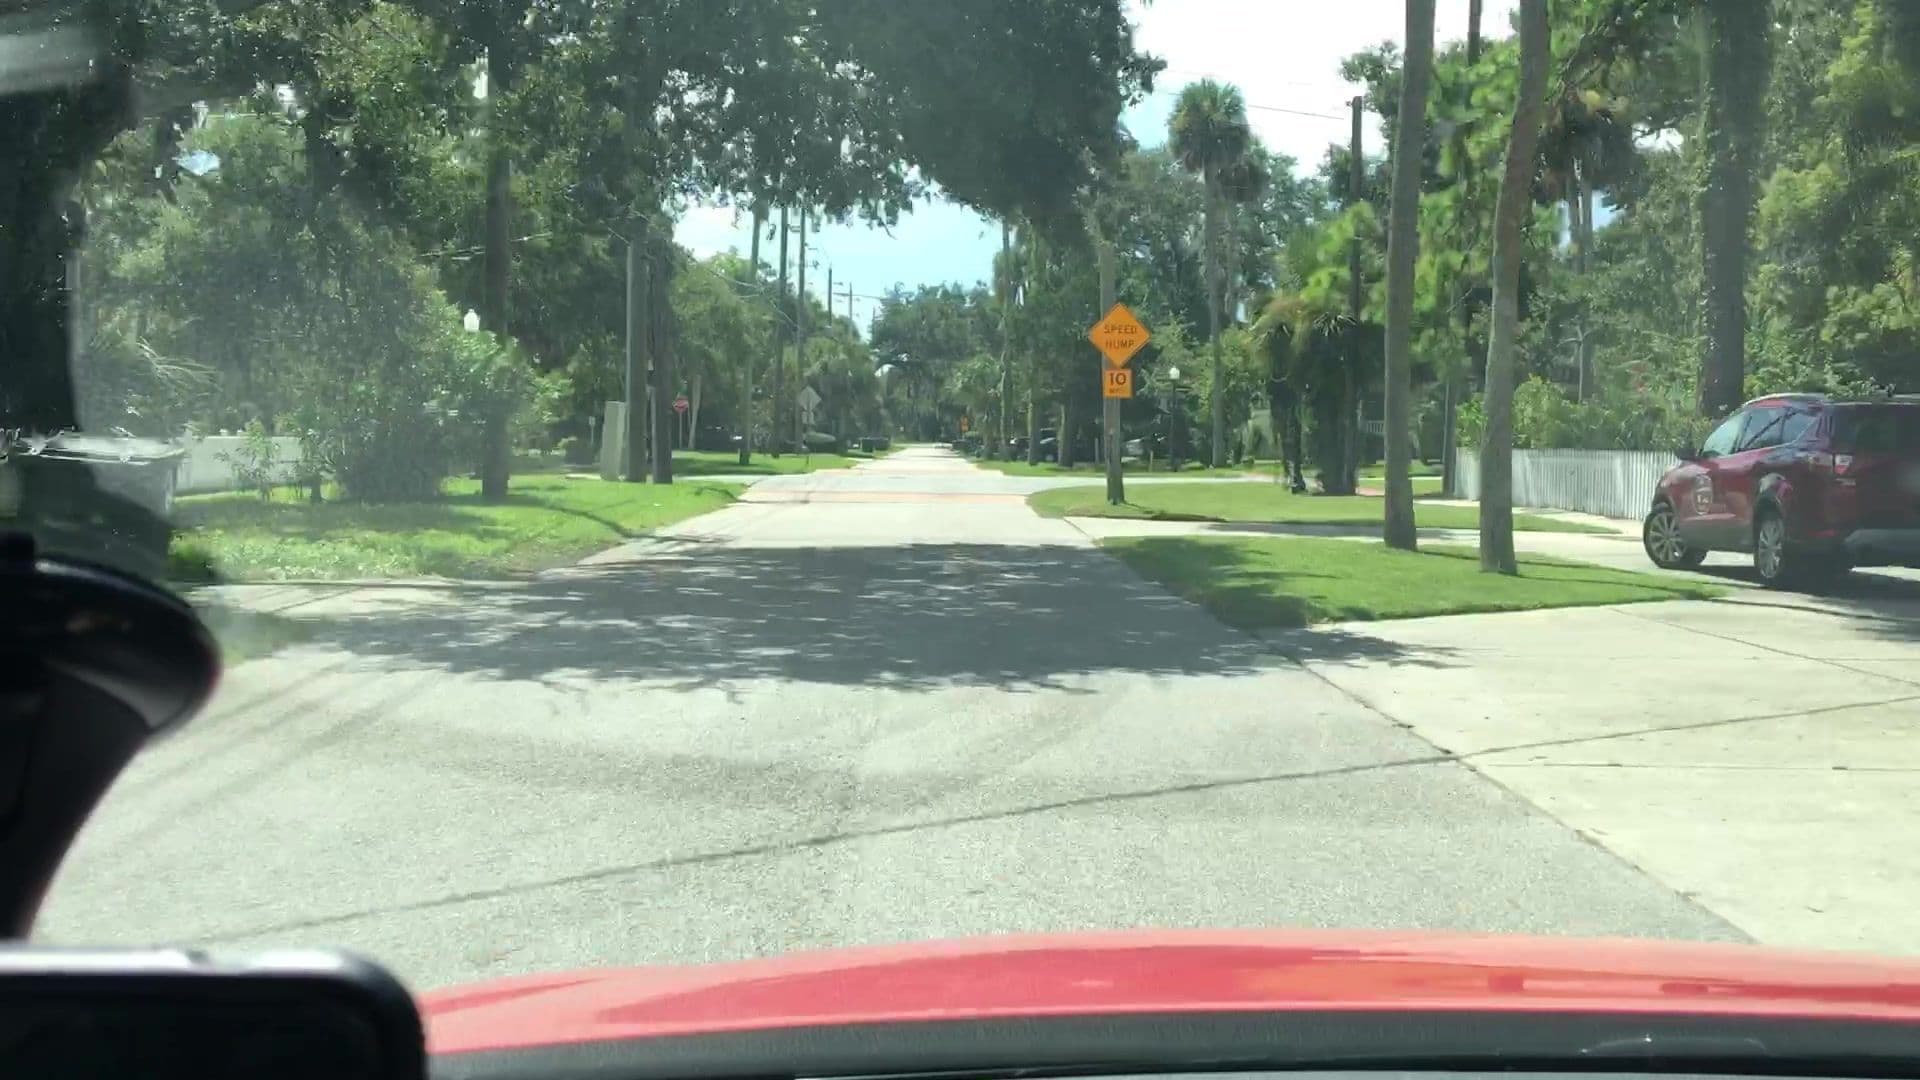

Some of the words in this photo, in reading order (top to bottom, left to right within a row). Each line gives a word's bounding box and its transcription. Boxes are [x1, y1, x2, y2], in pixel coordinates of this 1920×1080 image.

[1103, 324, 1137, 334] SPEED
[1105, 340, 1135, 349] HUMP
[1109, 372, 1127, 385] 10
